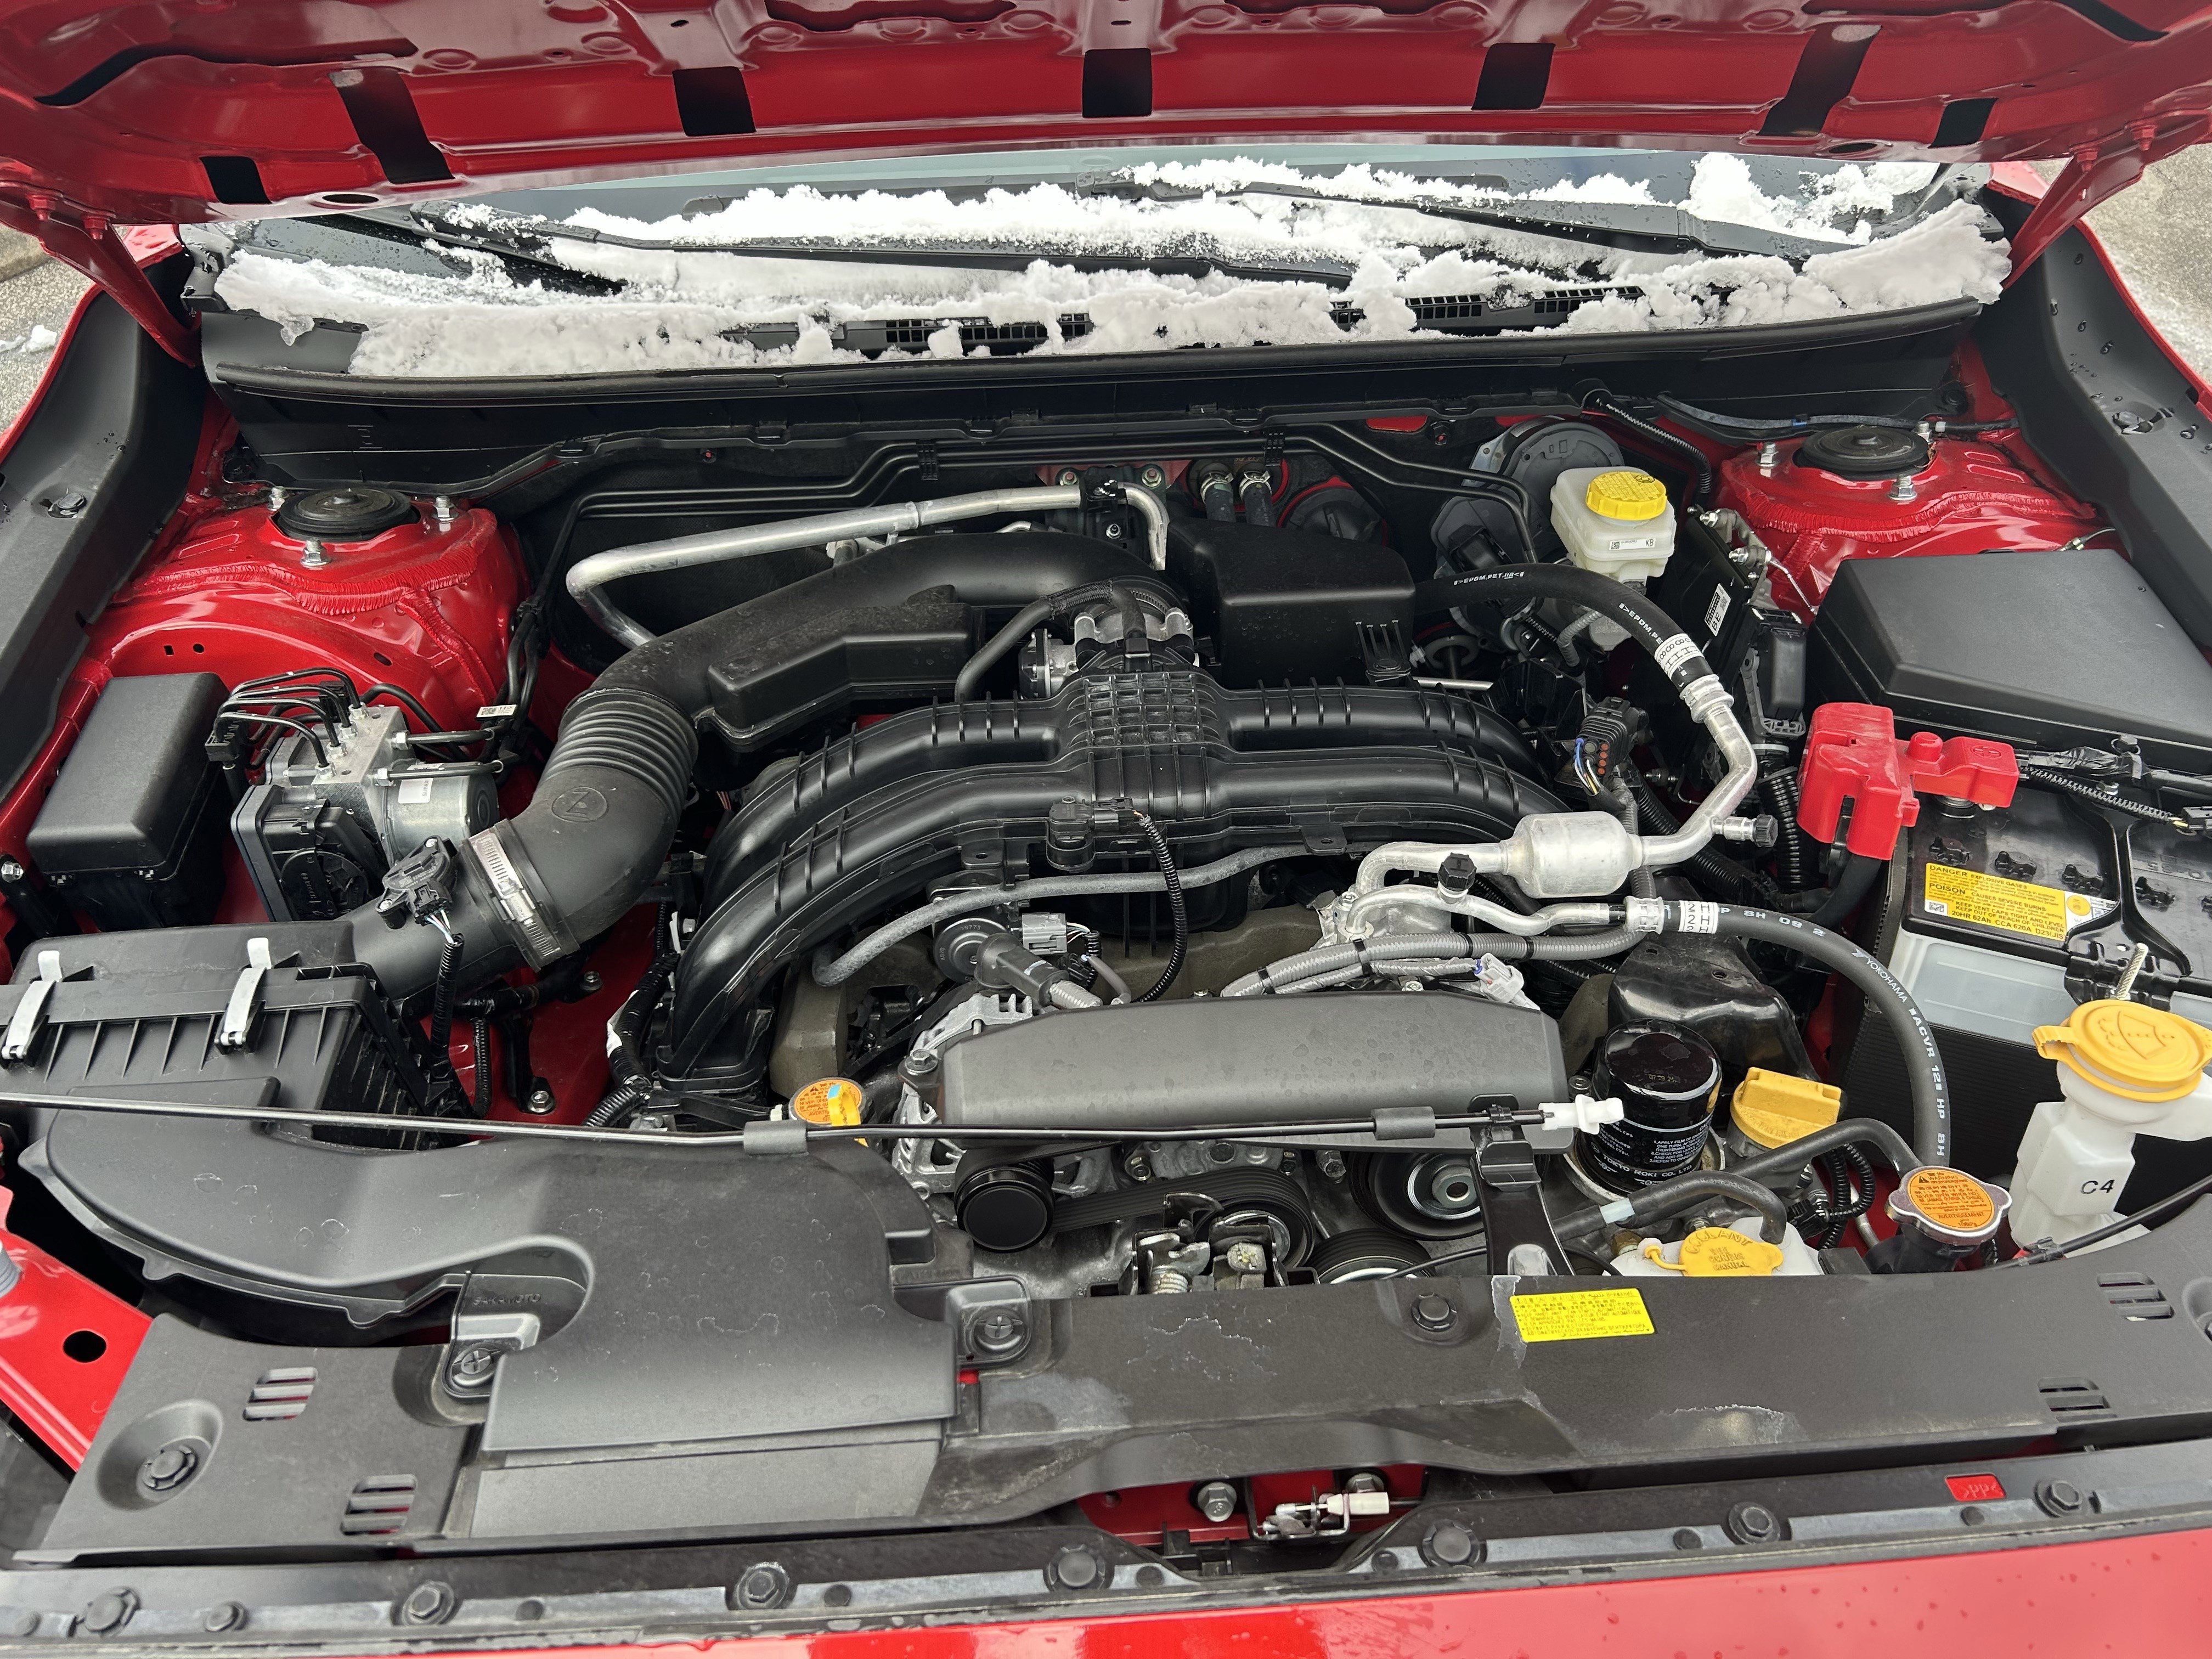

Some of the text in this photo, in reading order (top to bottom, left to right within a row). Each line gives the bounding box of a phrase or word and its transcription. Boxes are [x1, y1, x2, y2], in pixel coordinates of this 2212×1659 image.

[1645, 539, 1654, 547] KB
[1712, 612, 1722, 631] BE
[1929, 865, 1968, 877] DANGER
[1971, 874, 2005, 884] EXPLOSIVE
[1929, 882, 1966, 895] POISON
[1971, 892, 1996, 901] CAUSES
[1998, 898, 2023, 906] SEVERE
[2024, 903, 2046, 911] BURNS
[1688, 915, 1695, 924] 2
[1743, 910, 1766, 919] 8H
[1951, 910, 1971, 919] 20HR
[1972, 915, 1991, 923] 62Ah
[1995, 919, 2012, 928] CCA
[2013, 923, 2032, 932] 620A
[1998, 915, 2021, 923] REACH
[2032, 922, 2064, 933] CHILDREN
[2045, 920, 2065, 928] LEVEL
[1866, 958, 1908, 1003] YOKOHAMA
[1912, 1016, 1946, 1156] ACVR 12 HP 8H
[1602, 1153, 1630, 1172] TOKYO
[2081, 1179, 2115, 1194] C4
[1938, 1211, 1985, 1220] AVERTISSEMENT
[1685, 1230, 1753, 1255] COOLANT
